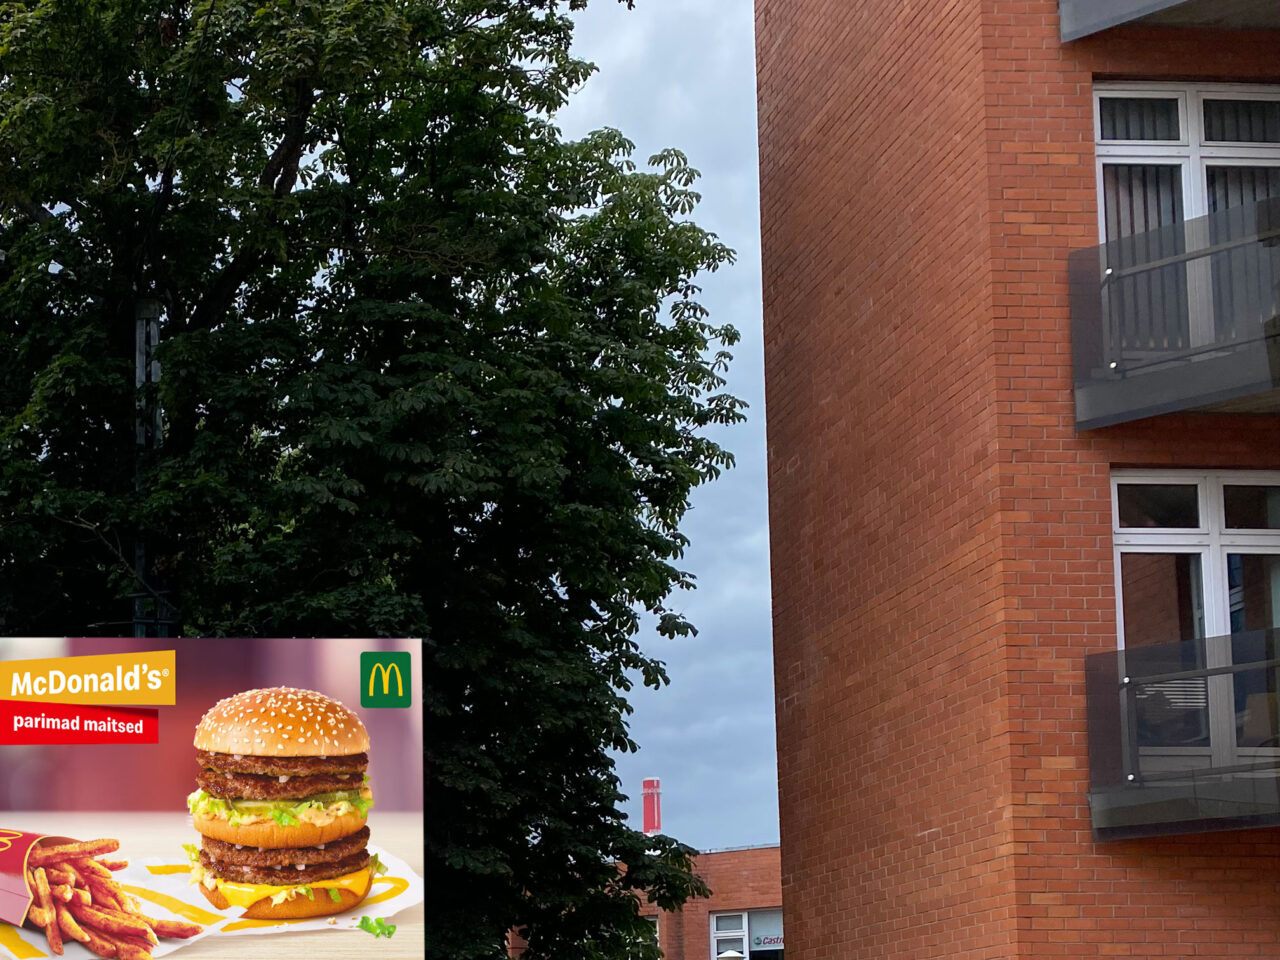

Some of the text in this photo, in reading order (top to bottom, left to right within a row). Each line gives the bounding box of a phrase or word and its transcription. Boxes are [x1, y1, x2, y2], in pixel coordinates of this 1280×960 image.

[13, 713, 143, 734] parimad maitsed
[762, 936, 784, 945] Castr
